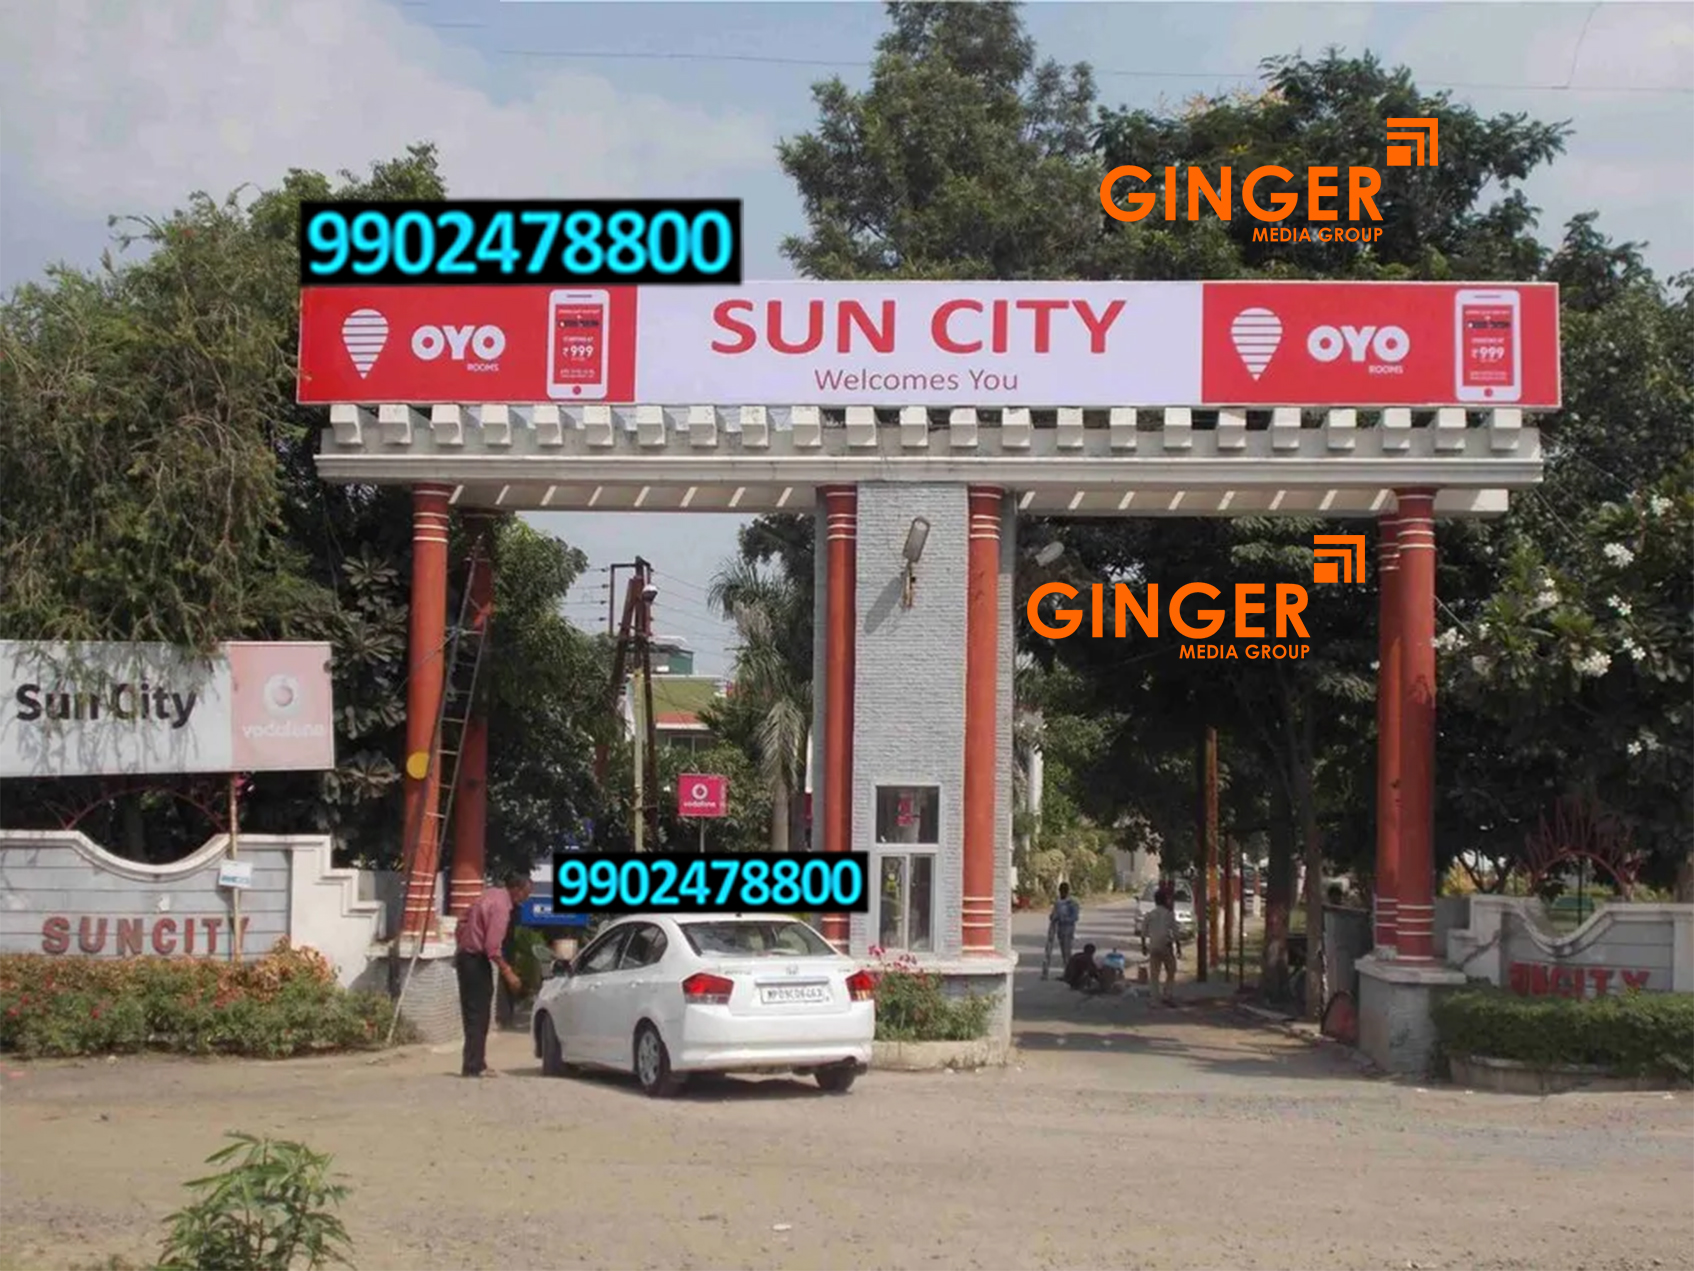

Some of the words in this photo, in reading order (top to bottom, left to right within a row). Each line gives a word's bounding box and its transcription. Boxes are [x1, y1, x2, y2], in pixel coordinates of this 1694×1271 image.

[411, 325, 506, 361] OYO
[711, 299, 896, 355] SUN
[930, 299, 1126, 355] CITY
[1307, 325, 1410, 362] OYO
[814, 368, 959, 391] Welcomes
[968, 369, 1018, 391] You
[16, 683, 100, 721] Sun
[112, 681, 198, 729] City
